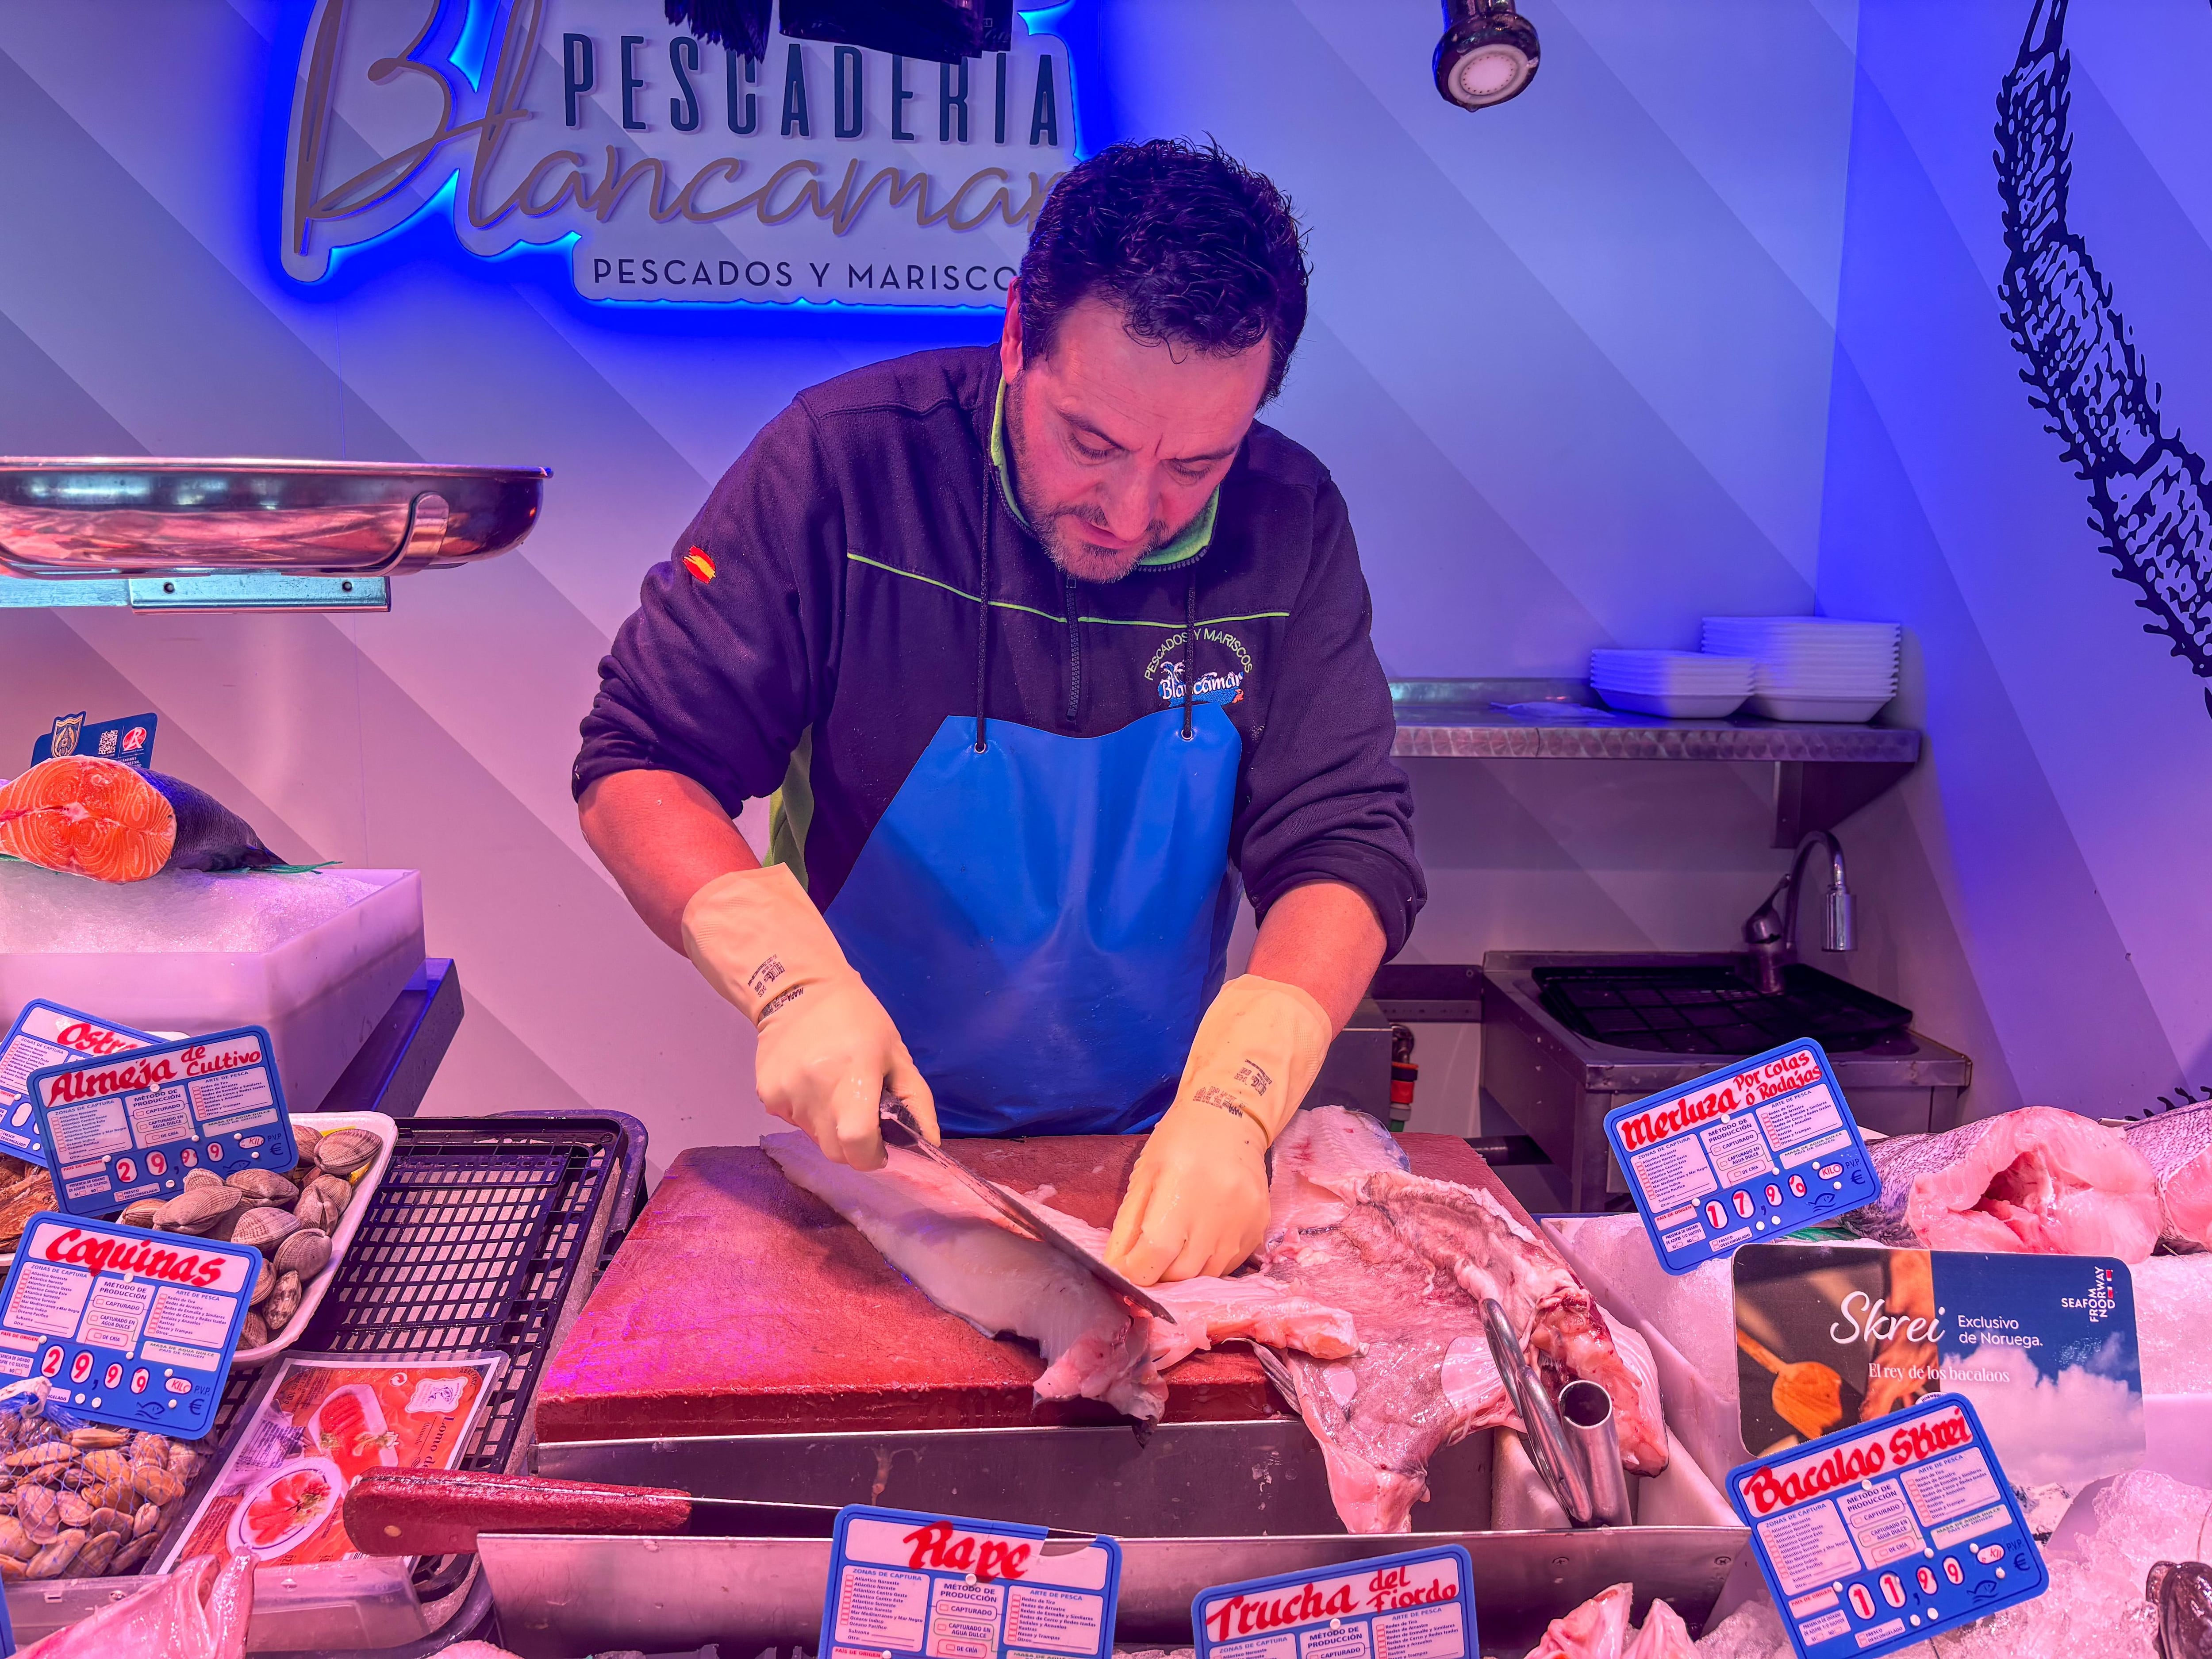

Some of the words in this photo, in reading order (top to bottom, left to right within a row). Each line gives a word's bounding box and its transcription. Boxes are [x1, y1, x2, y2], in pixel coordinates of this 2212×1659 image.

[594, 258, 792, 287] PESCADOS
[809, 261, 831, 288] Y
[848, 264, 1018, 292] MARISCO
[1144, 632, 1188, 681] PESCADOS
[1193, 628, 1202, 640] Y
[1203, 628, 1253, 673] MARISCOS
[186, 1050, 261, 1076] Cultivo
[47, 1058, 178, 1108] Almeja
[181, 1045, 206, 1063] de
[1733, 1071, 1760, 1091] Por
[1764, 1052, 1810, 1077] Colas
[1757, 1065, 1823, 1100] Rodajas
[132, 1093, 181, 1107] PRODUCCIÓN
[133, 1091, 165, 1102] MÉTODO
[1793, 1090, 1812, 1099] PESCA
[86, 1099, 114, 1108] CAPTURA
[145, 1103, 181, 1114] CAPTURADO
[1621, 1087, 1743, 1150] Merluza
[1707, 1121, 1737, 1137] MÉTODO
[1708, 1122, 1752, 1143] PRODUCCIÓN
[1637, 1149, 1656, 1160] ZONAS
[1665, 1137, 1691, 1149] CAPTURA
[1721, 1133, 1754, 1149] CAPTURADO
[1727, 1148, 1753, 1161] CAPTURADO
[1731, 1156, 1745, 1165] AGUA
[1744, 1151, 1759, 1160] DULCE
[1821, 1164, 1841, 1176] KILO
[1718, 1235, 1733, 1244] FRESCO
[1720, 1233, 1751, 1248] DESCONGELADO
[46, 1228, 227, 1288] Coquinas
[61, 1270, 87, 1278] CAPTURA
[99, 1286, 147, 1300] PRODUCCIÓN
[103, 1279, 135, 1291] MÉTODO
[2094, 1266, 2108, 1317] NORWAY
[105, 1300, 140, 1311] CAPTURADO
[2061, 1297, 2116, 1309] SEAFOOD
[2088, 1288, 2099, 1322] FROM
[1830, 1291, 1946, 1344] Skrei
[1958, 1315, 2019, 1330] Exclusivo
[1959, 1332, 1977, 1344] de
[1980, 1333, 2043, 1348] Noruega.
[1868, 1363, 1882, 1378] El
[1883, 1366, 1904, 1382] rey
[1908, 1365, 1925, 1380] de
[1927, 1366, 1947, 1380] los
[1949, 1366, 2010, 1382] bacalaos
[430, 1417, 455, 1452] Lomo
[1917, 1464, 1933, 1473] ARTE
[1943, 1454, 1963, 1464] PESCA
[1743, 1440, 1886, 1513] Bacalao
[1846, 1487, 1880, 1504] MÉTODO
[1846, 1489, 1898, 1512] PRODUCCIÓN
[1765, 1517, 1787, 1528] ZONAS
[1797, 1502, 1827, 1517] CAPTURA
[1863, 1503, 1901, 1521] CAPTURADO
[903, 1520, 1031, 1583] Rape
[853, 1567, 877, 1575] ZONAS
[890, 1572, 922, 1581] CAPTURA
[944, 1582, 981, 1593] MÉTODO
[940, 1589, 997, 1603] PRODUCCIÓN
[1206, 1581, 1360, 1642] Trucha
[1368, 1566, 1411, 1592] del
[1366, 1578, 1457, 1615] Fiordo
[951, 1605, 992, 1616] CAPTURADO
[949, 1622, 982, 1632] CAPTURADO
[1309, 1628, 1345, 1640] MÉTODO
[1219, 1644, 1242, 1653] ZONAS
[1256, 1636, 1287, 1646] CAPTURA
[1307, 1632, 1363, 1648] PRODUCCIÓN
[1320, 1647, 1361, 1659] CAPTURADO
